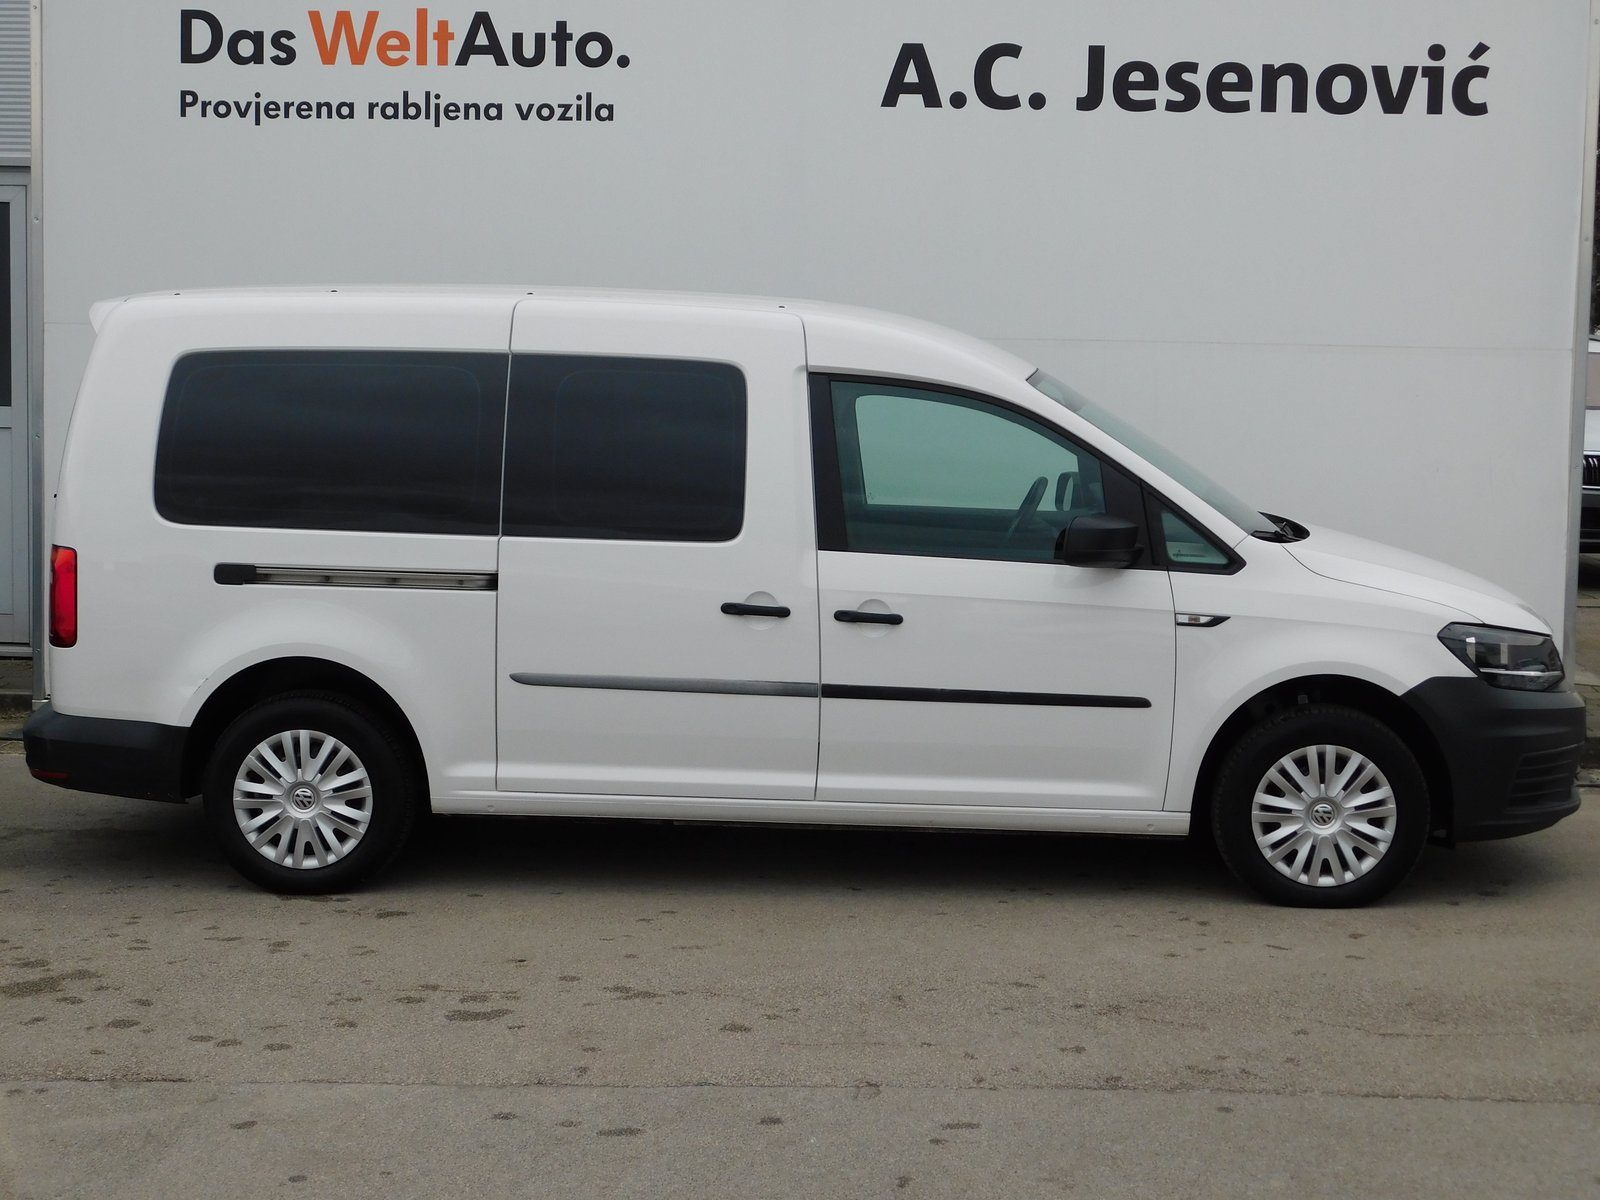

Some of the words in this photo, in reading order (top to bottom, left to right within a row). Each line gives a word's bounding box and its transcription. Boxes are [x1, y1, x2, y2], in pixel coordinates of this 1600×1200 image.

[179, 8, 297, 67] Das
[307, 7, 631, 69] WeltAuto.
[179, 89, 356, 127] Provjerena
[367, 90, 504, 128] rabljena
[514, 91, 615, 123] vozila
[880, 42, 1047, 111] A.C.
[1076, 41, 1491, 117] Jesenović
